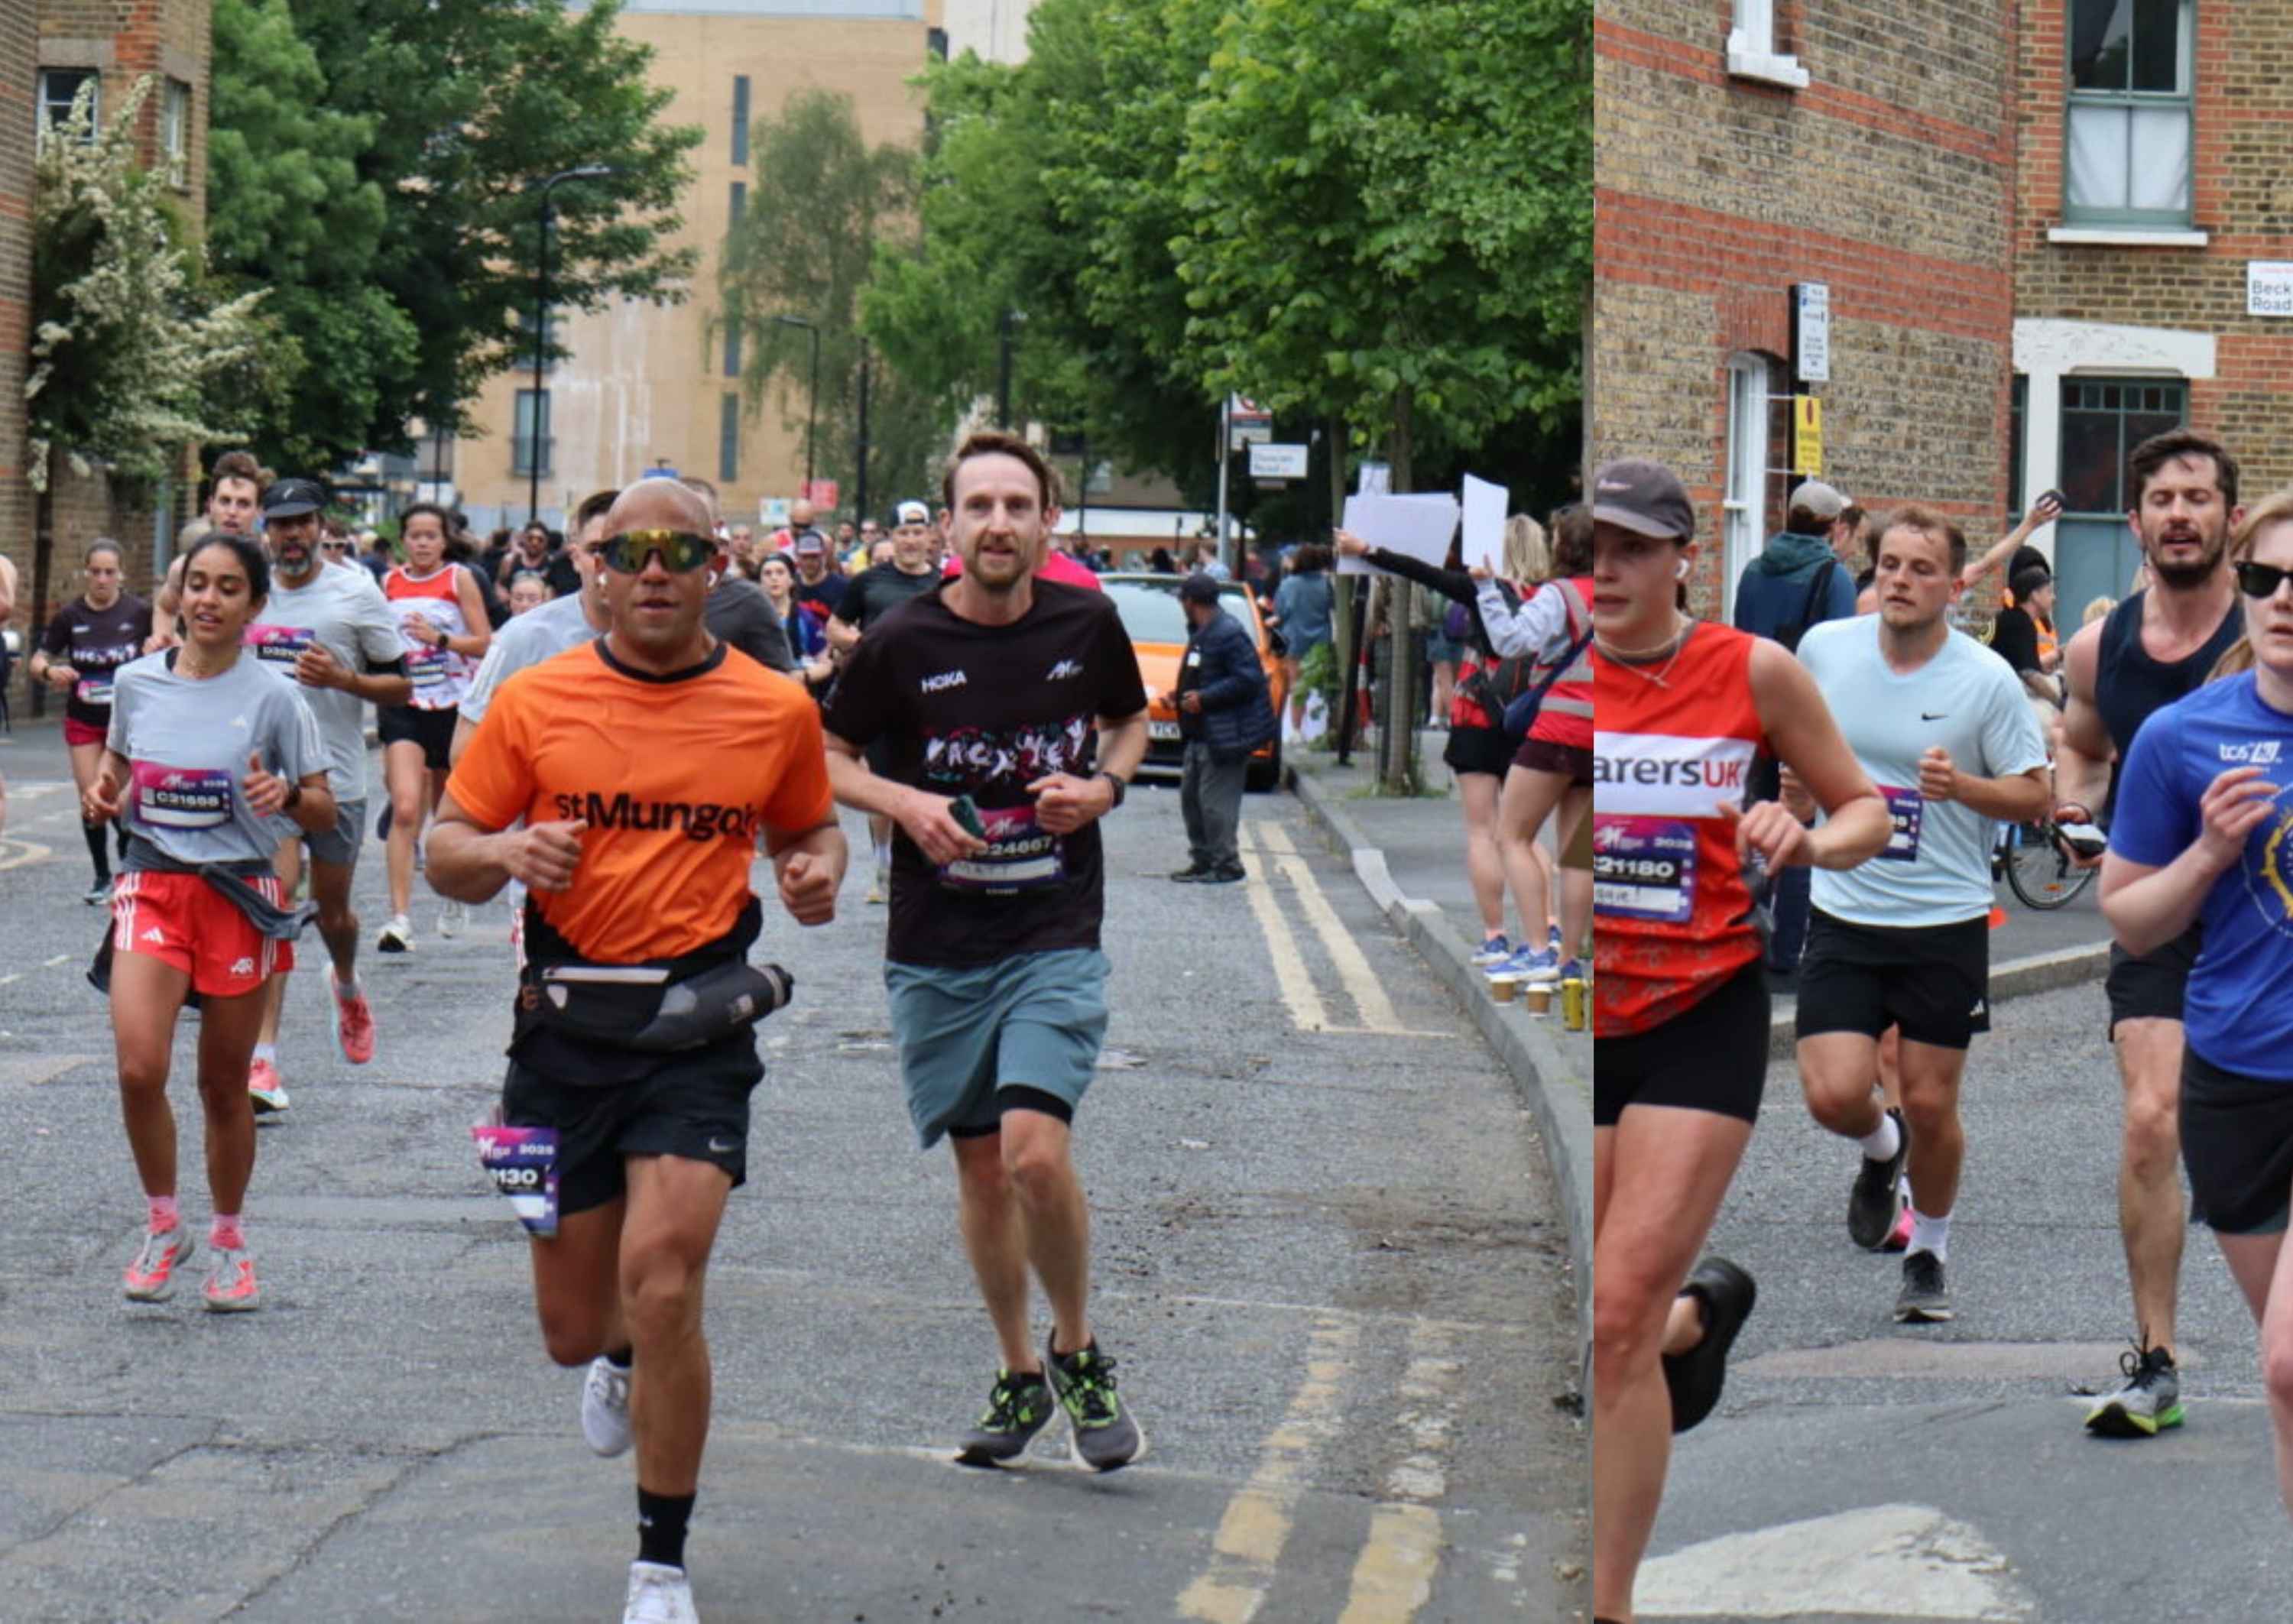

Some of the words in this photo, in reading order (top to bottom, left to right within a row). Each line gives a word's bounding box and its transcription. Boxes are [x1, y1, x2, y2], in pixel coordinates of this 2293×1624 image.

[2251, 280, 2291, 295] Beck
[2251, 296, 2292, 311] Road
[921, 670, 968, 693] HOKA
[1594, 854, 1675, 878] 21180
